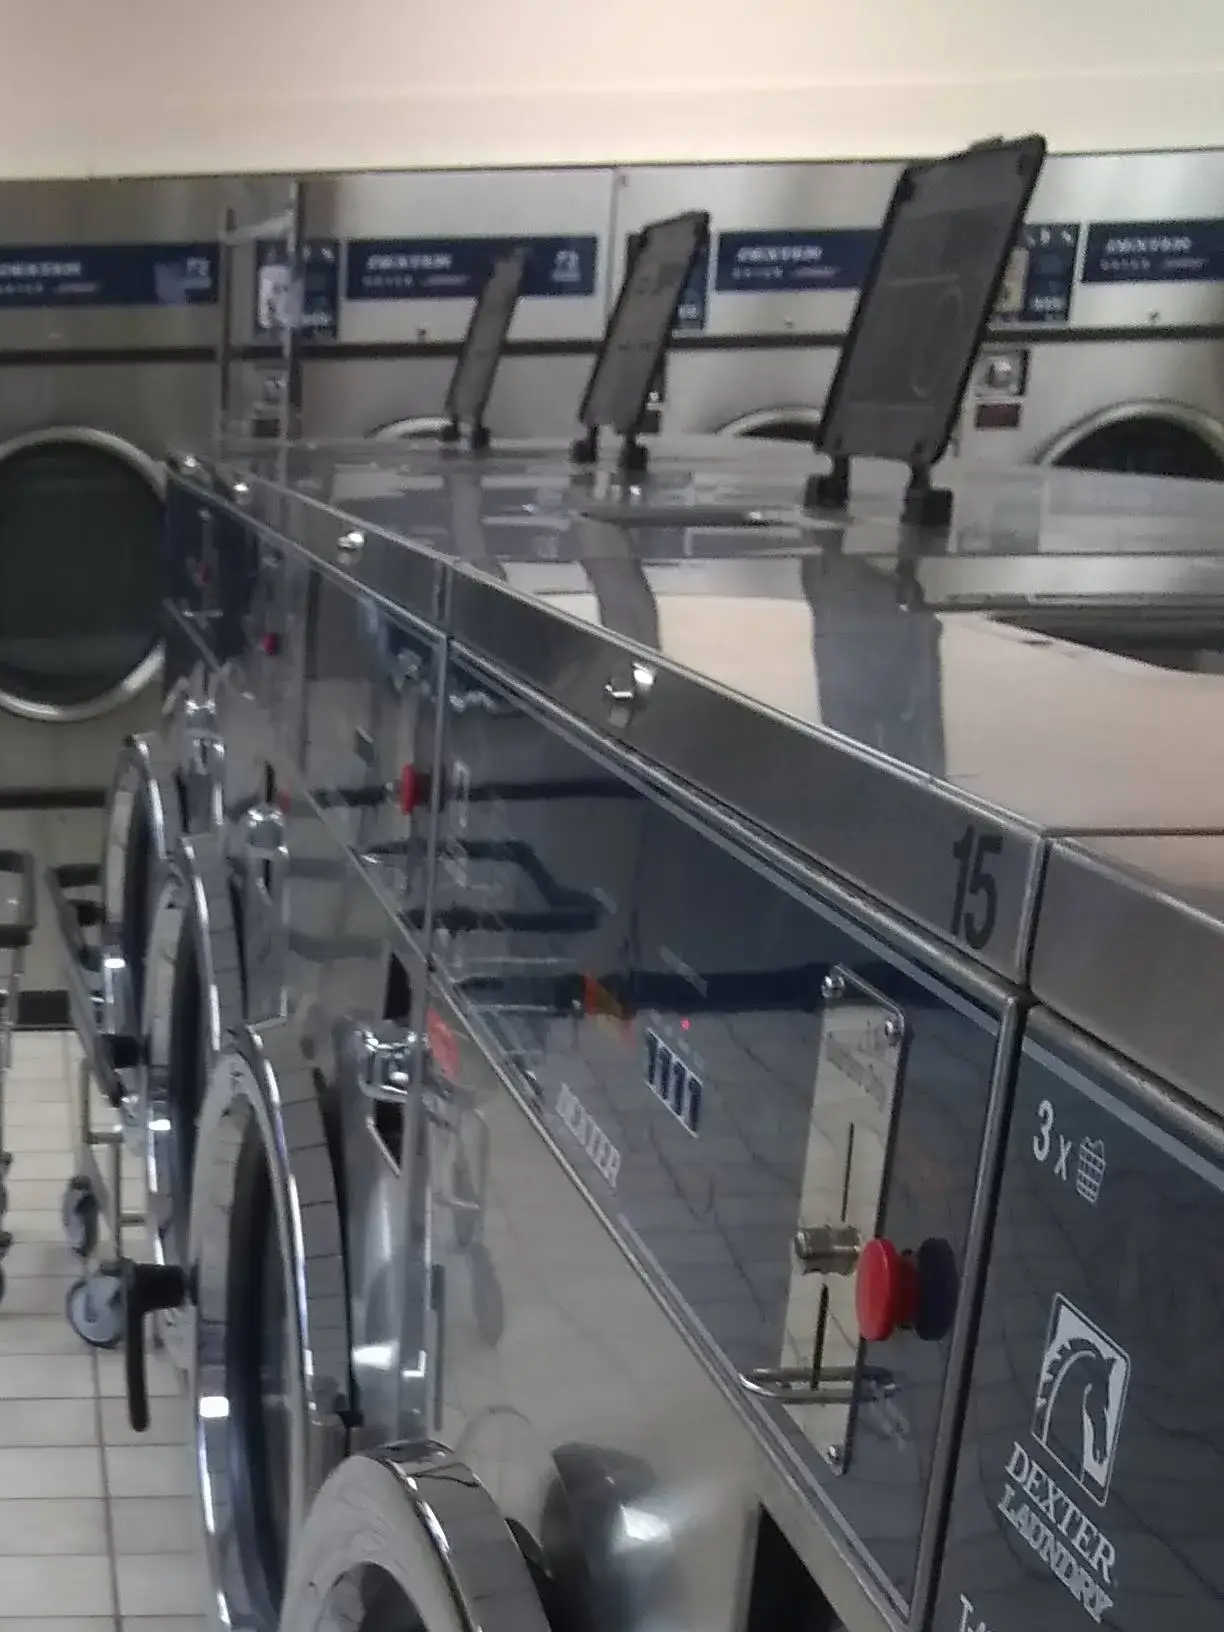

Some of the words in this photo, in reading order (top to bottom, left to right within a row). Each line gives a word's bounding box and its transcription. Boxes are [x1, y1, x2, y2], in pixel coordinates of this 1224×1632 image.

[953, 824, 1003, 949] 15
[1033, 1100, 1054, 1161] 3
[1054, 1135, 1072, 1180] x
[998, 1484, 1114, 1624] LAUNDRY
[1004, 1441, 1117, 1584] DEXTER
